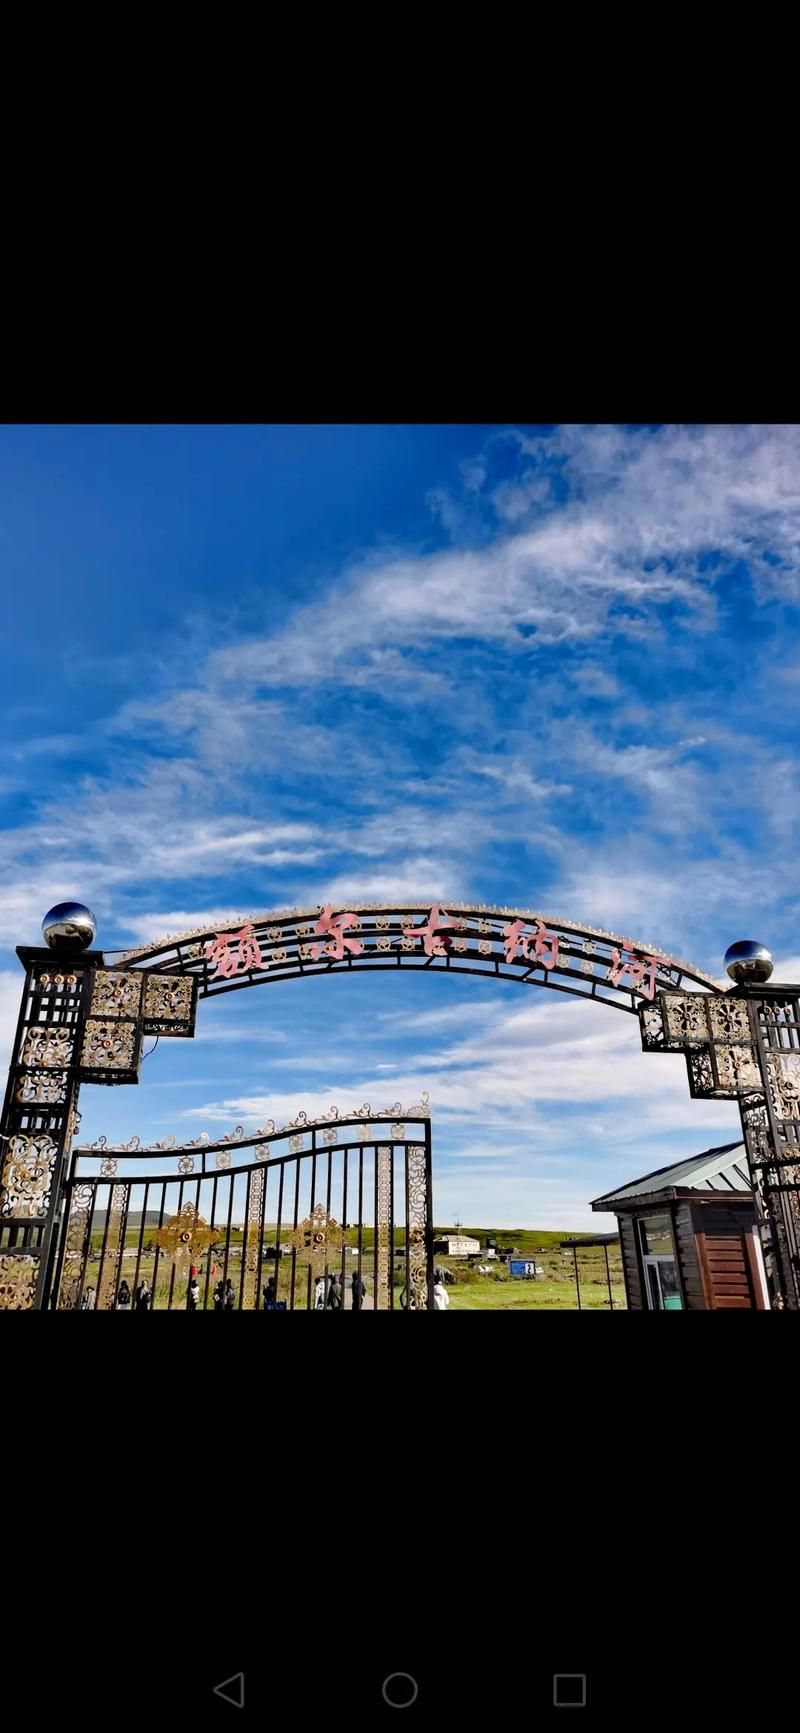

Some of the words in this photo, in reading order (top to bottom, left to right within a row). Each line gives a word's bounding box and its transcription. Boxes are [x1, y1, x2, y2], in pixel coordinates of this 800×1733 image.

[204, 904, 671, 1001] 额尔古纳河
